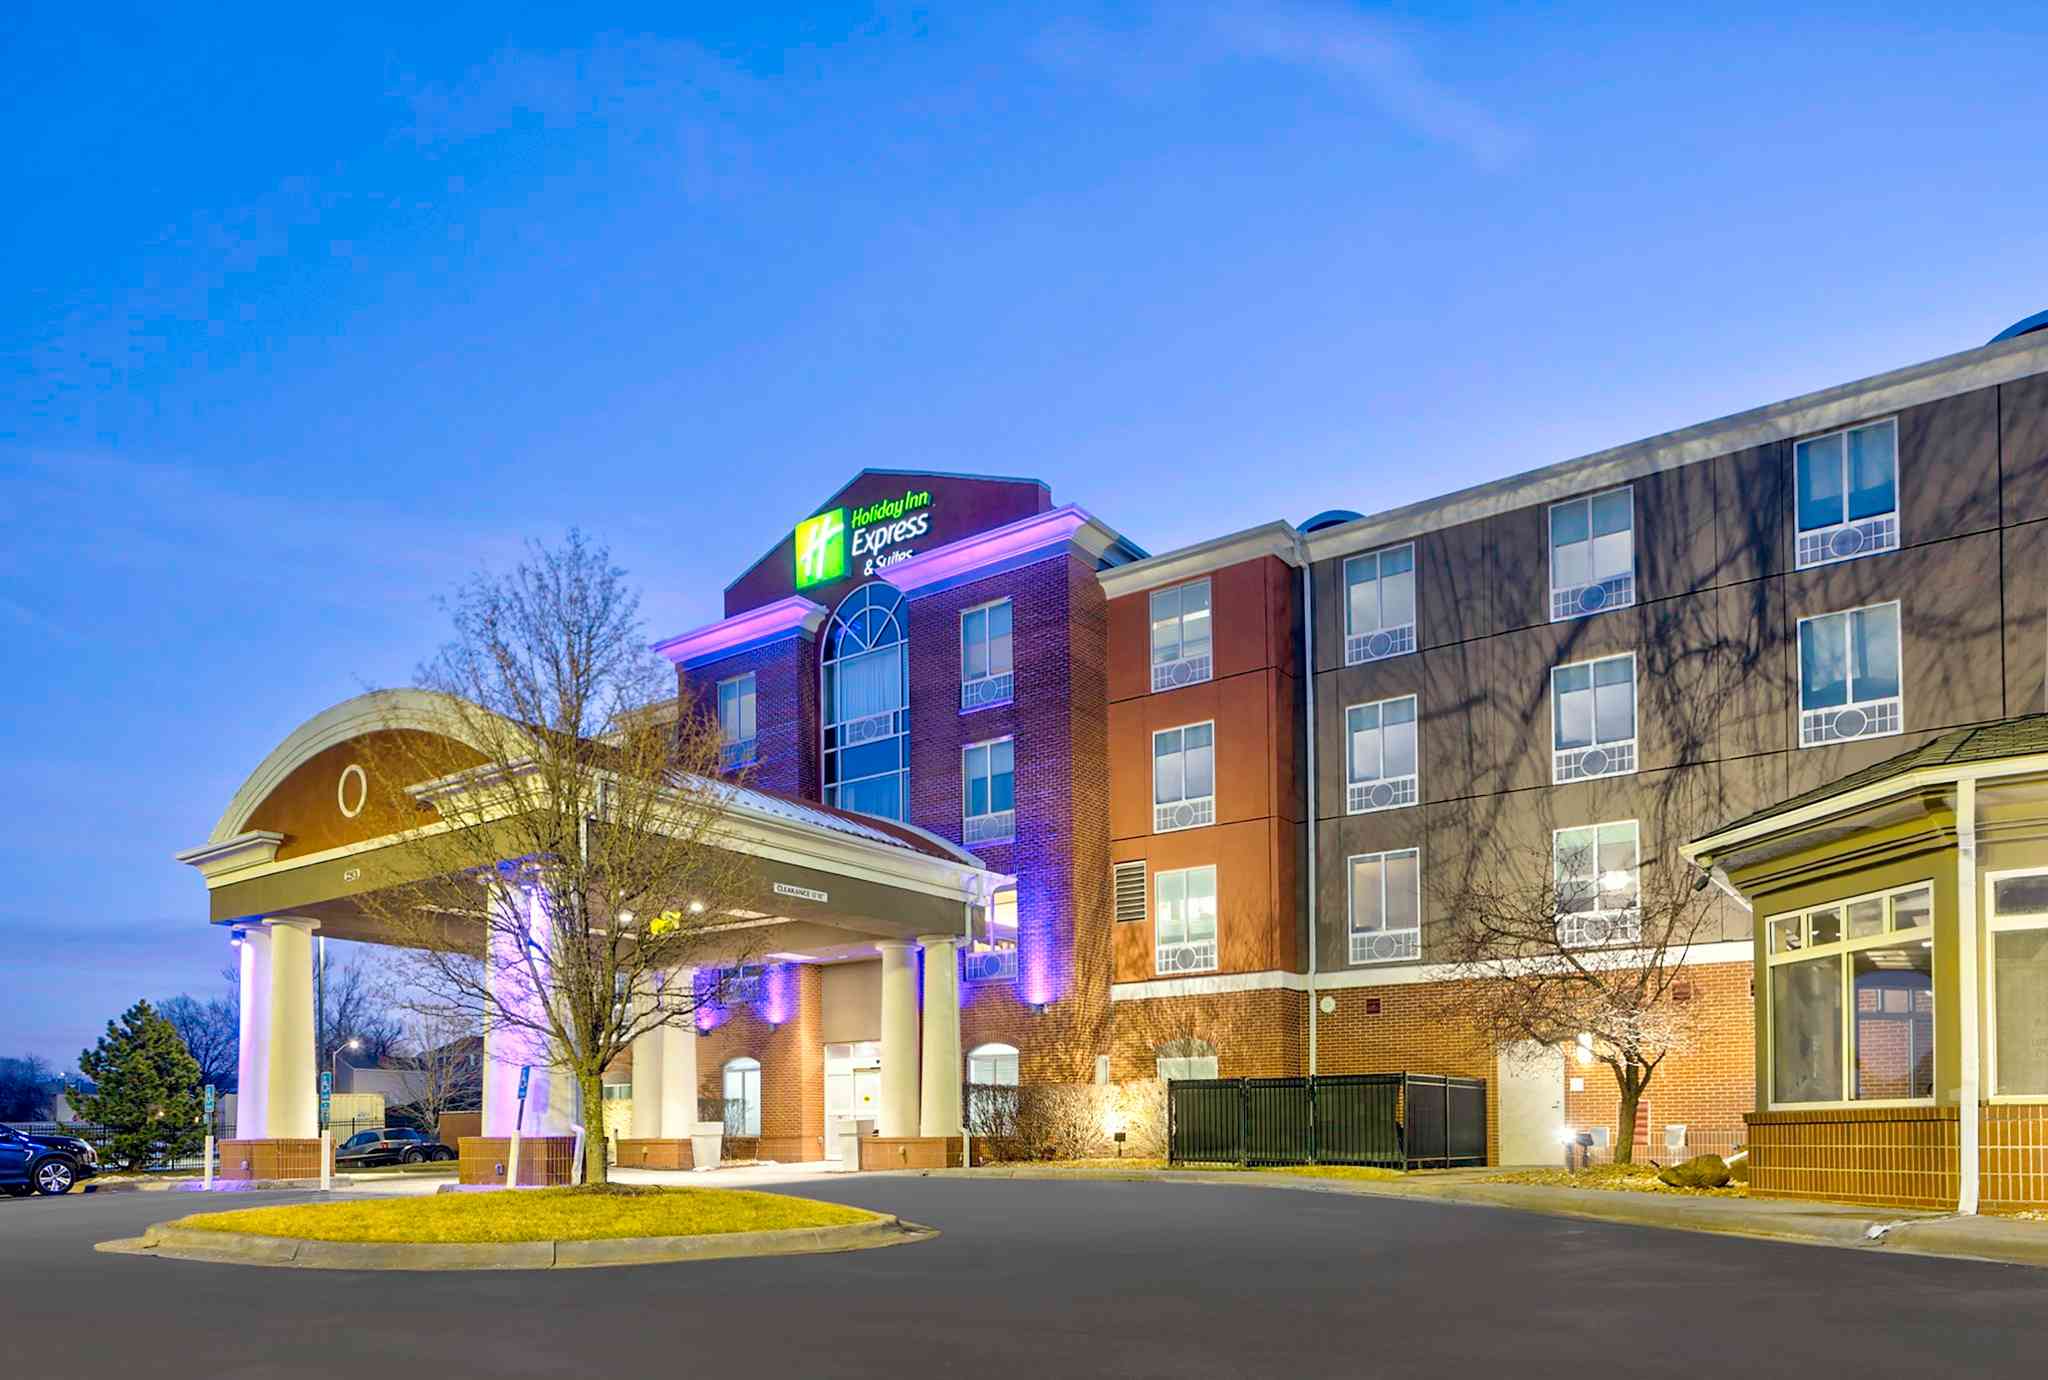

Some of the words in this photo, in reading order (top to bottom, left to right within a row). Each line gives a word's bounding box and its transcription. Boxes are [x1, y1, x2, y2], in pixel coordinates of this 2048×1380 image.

[851, 500, 904, 528] Holiday
[904, 490, 929, 509] Inn
[851, 512, 929, 556] Express
[863, 559, 874, 576] &
[875, 549, 914, 570] Suites
